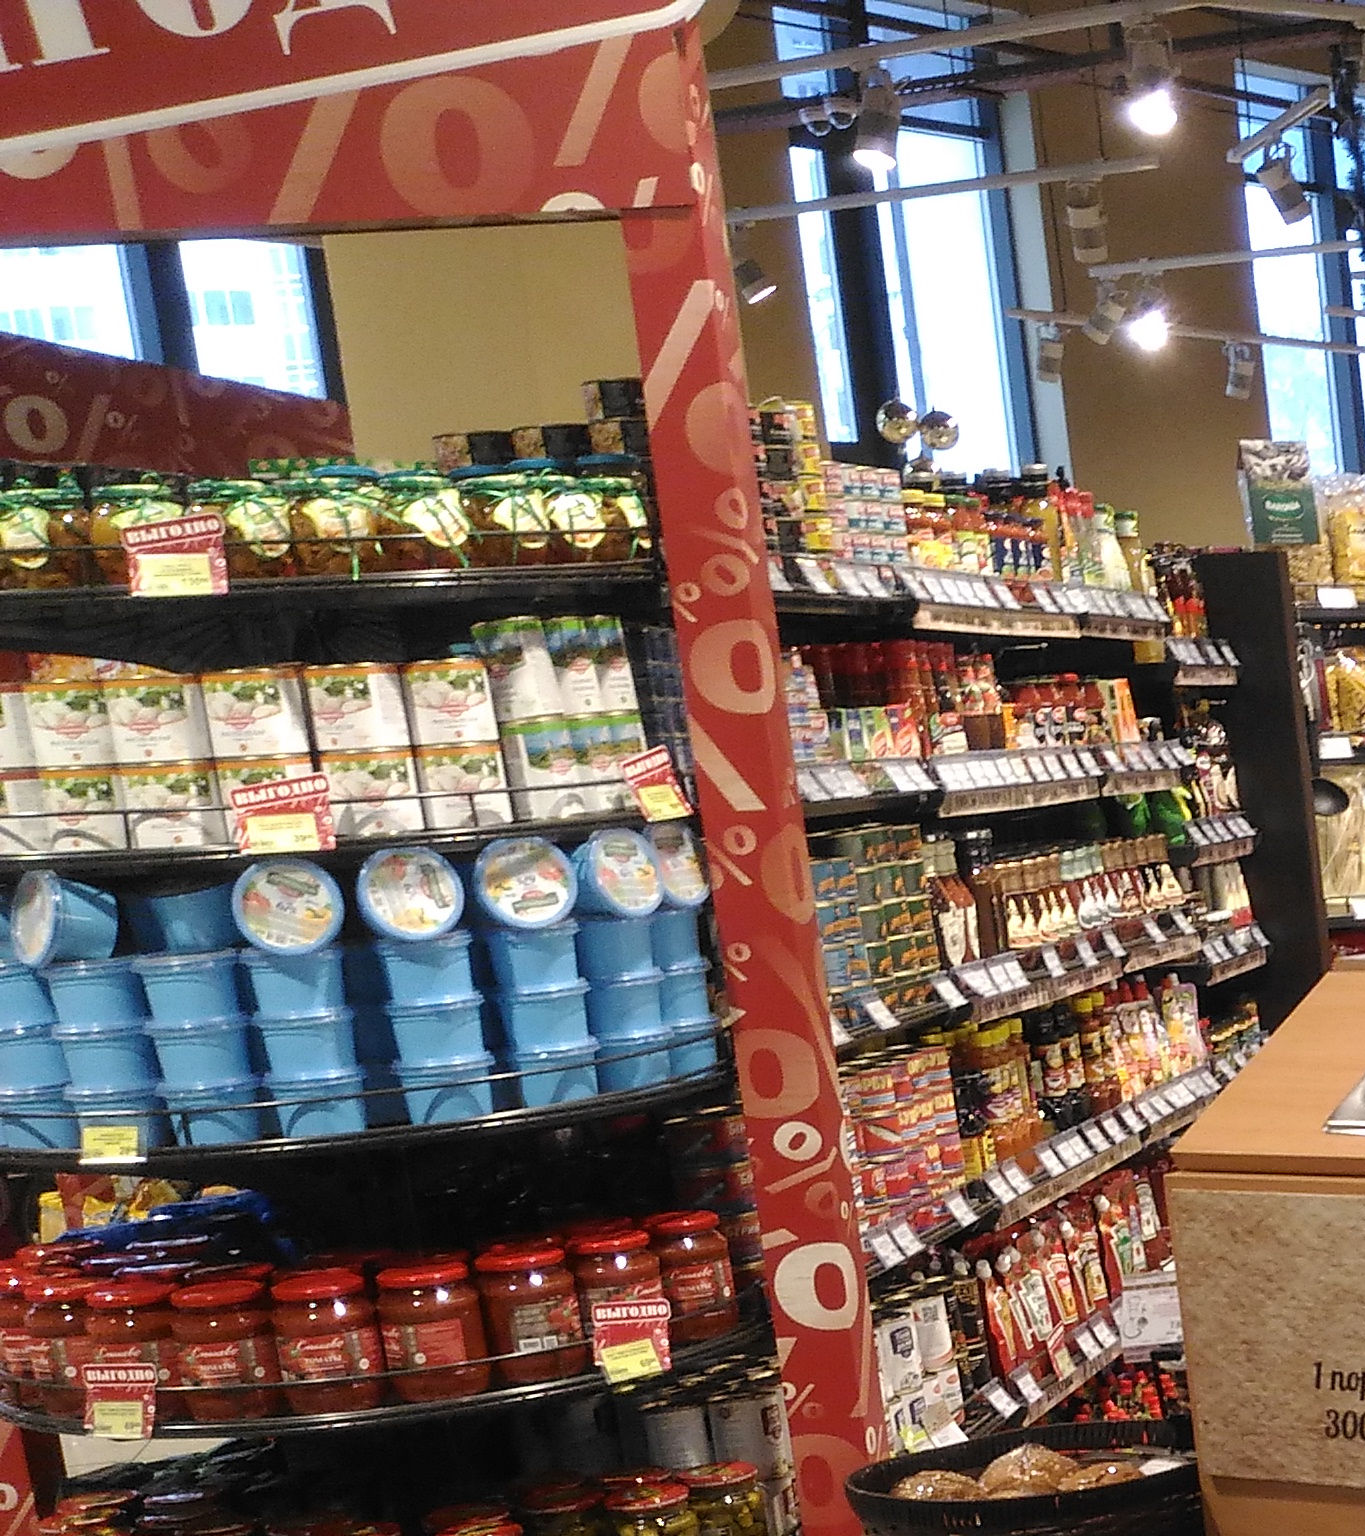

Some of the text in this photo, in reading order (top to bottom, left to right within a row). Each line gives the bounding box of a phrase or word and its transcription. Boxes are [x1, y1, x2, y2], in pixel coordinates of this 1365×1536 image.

[126, 518, 220, 545] ВЫГОДНО
[233, 778, 327, 806] ВЫГОДНО
[595, 1304, 668, 1320] ВЫГОДНО
[85, 1368, 155, 1381] ВЫГОДНО
[1313, 1361, 1323, 1390] 1
